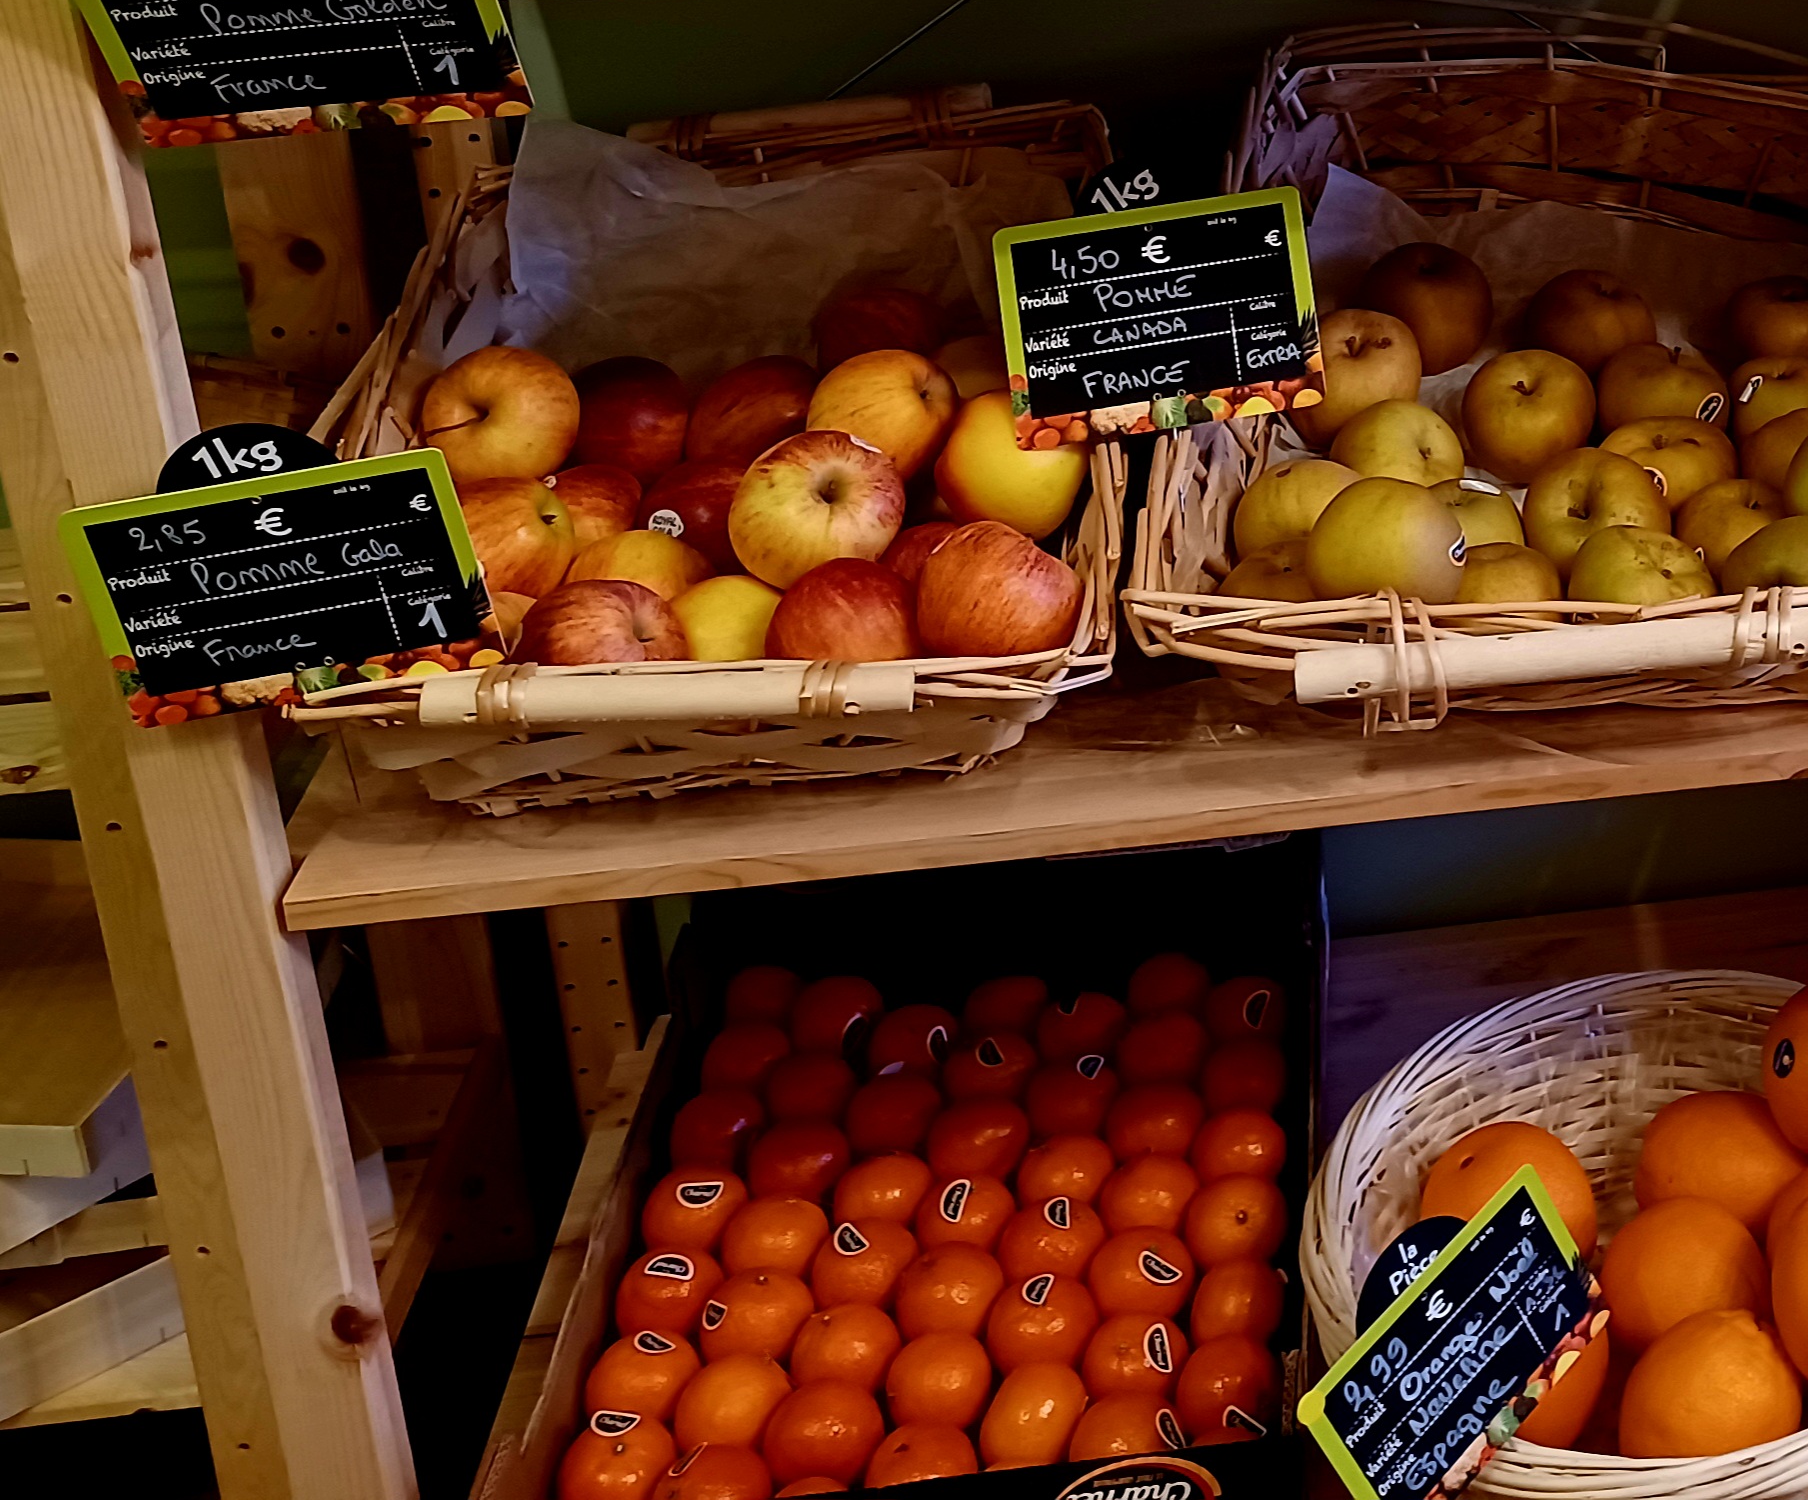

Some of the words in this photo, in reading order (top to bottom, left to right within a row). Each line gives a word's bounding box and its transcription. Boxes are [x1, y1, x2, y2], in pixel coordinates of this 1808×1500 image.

[110, 4, 179, 23] Produit
[200, 2, 325, 38] Pomme
[131, 43, 192, 62] Variété
[432, 54, 460, 86] 1
[142, 67, 207, 88] Origine
[209, 72, 328, 105] France
[1090, 168, 1160, 213] 1kg
[1263, 228, 1283, 248] €
[1050, 244, 1120, 281] 4,50
[1140, 234, 1172, 265] €
[1018, 290, 1070, 311] Produit
[1092, 273, 1197, 313] POMME
[1025, 334, 1072, 354] Variété
[1093, 315, 1189, 345] CANADA
[1028, 360, 1078, 381] Origine
[1245, 342, 1302, 370] EXTRA
[1082, 359, 1191, 400] FRANCE
[192, 437, 284, 480] 1kg
[409, 493, 433, 513] €
[253, 506, 293, 538] €
[107, 570, 172, 593] Produit
[190, 550, 325, 596] Pomme
[124, 611, 183, 635] Variété
[418, 603, 447, 639] 1
[135, 637, 196, 660] Origine
[202, 631, 318, 668] France
[1398, 1242, 1418, 1264] la
[1425, 1288, 1454, 1322] €
[1344, 1402, 1388, 1450] Produit
[1398, 1315, 1484, 1403] Orange
[1403, 1374, 1520, 1491] Espagne
[1376, 1452, 1419, 1497] Origine
